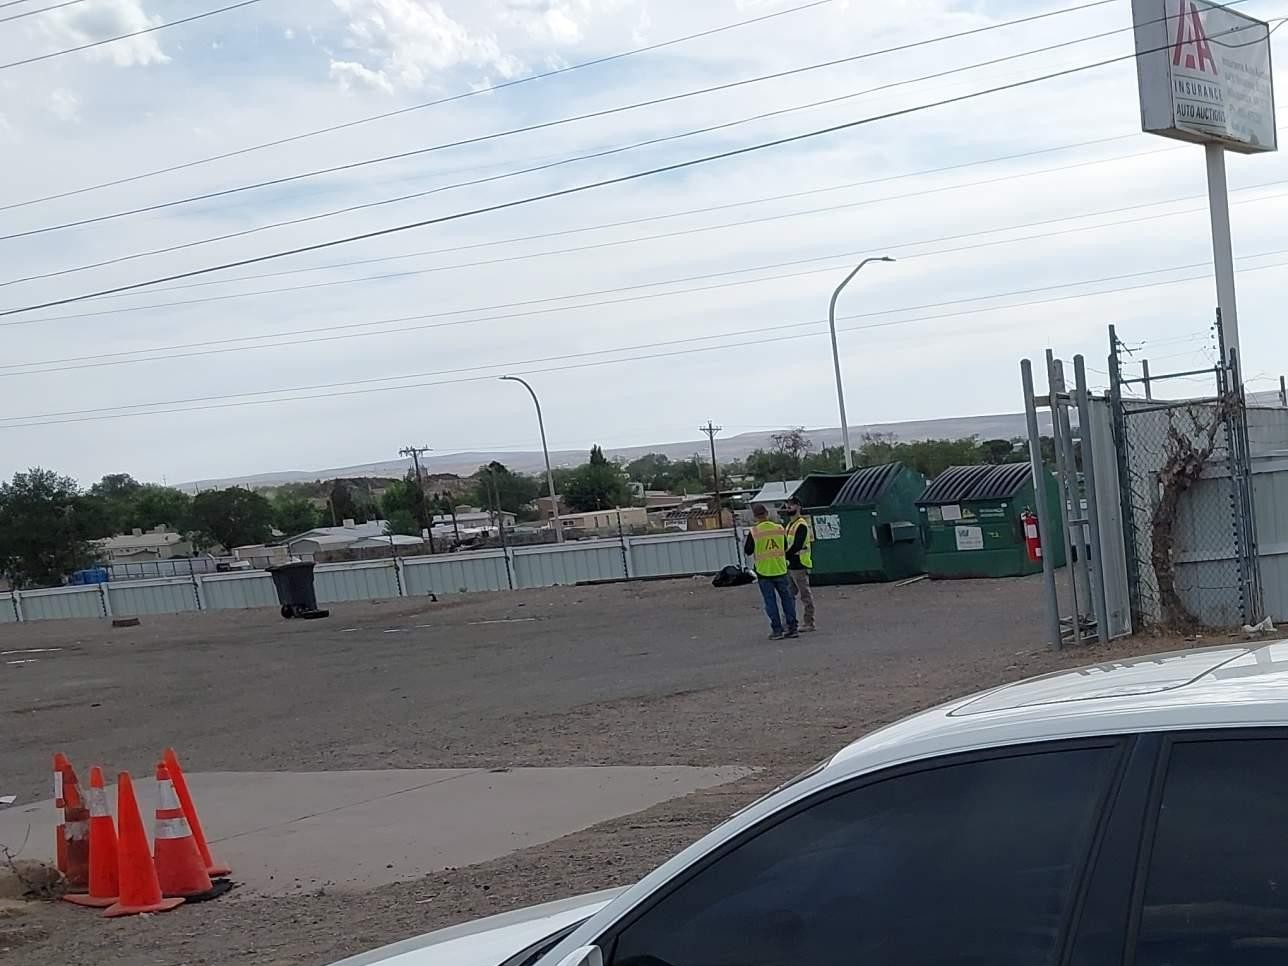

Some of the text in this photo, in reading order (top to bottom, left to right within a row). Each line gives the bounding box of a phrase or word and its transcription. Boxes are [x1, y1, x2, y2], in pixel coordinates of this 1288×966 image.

[1174, 80, 1223, 101] INSURANCE
[1176, 103, 1195, 117] AUTO
[1196, 106, 1226, 123] AUCTIONS
